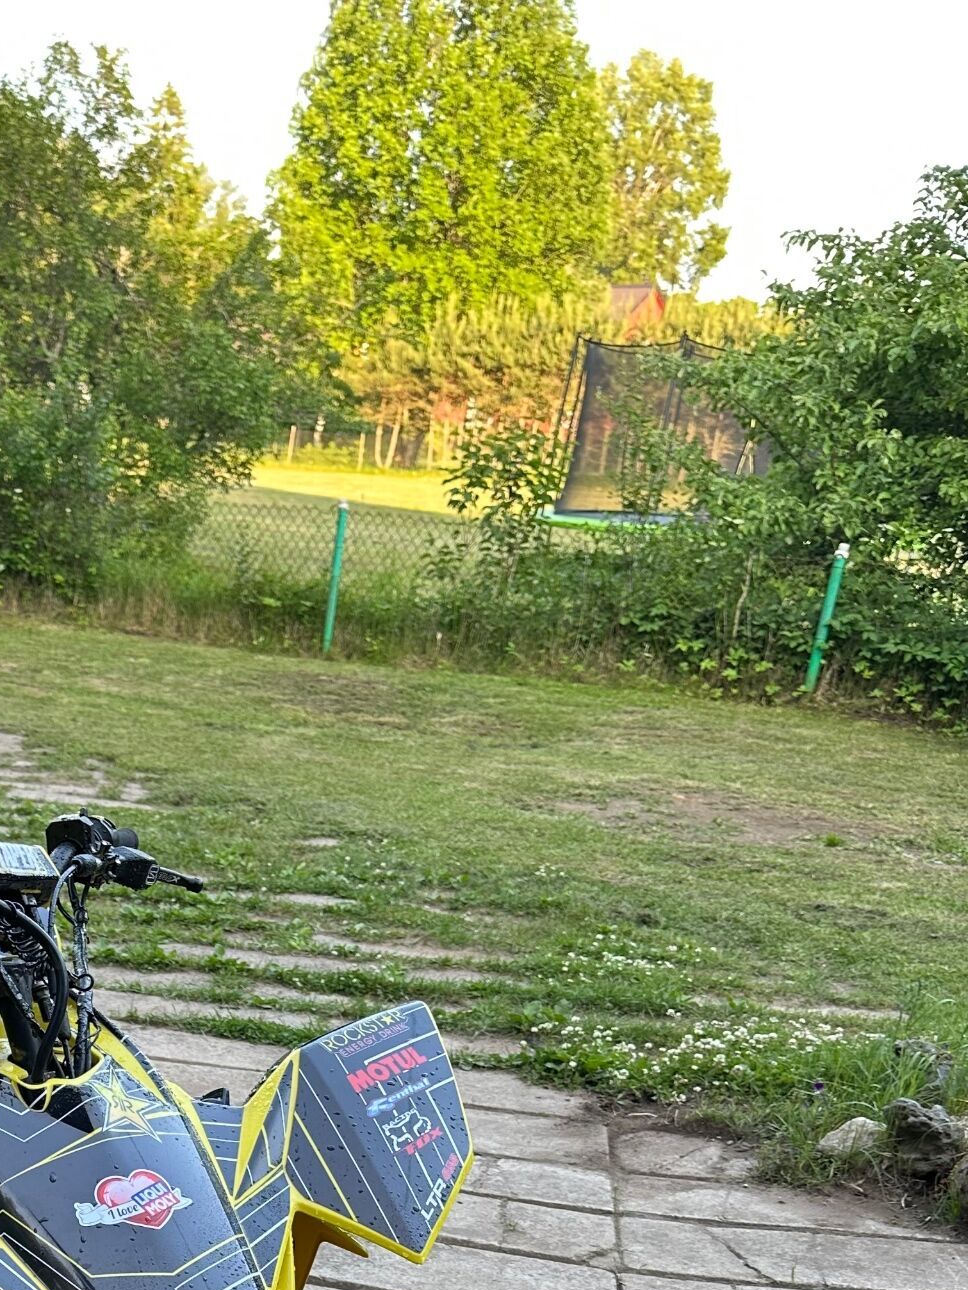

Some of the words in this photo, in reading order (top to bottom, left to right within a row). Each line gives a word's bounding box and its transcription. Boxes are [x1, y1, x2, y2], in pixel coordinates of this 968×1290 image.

[339, 1035, 378, 1057] ENERGY
[378, 1022, 408, 1039] DRINK
[346, 1046, 427, 1094] MOTUL
[133, 1182, 168, 1206] LIQUI
[144, 1192, 178, 1216] MOLY
[107, 1209, 116, 1220] I
[117, 1204, 139, 1217] love
